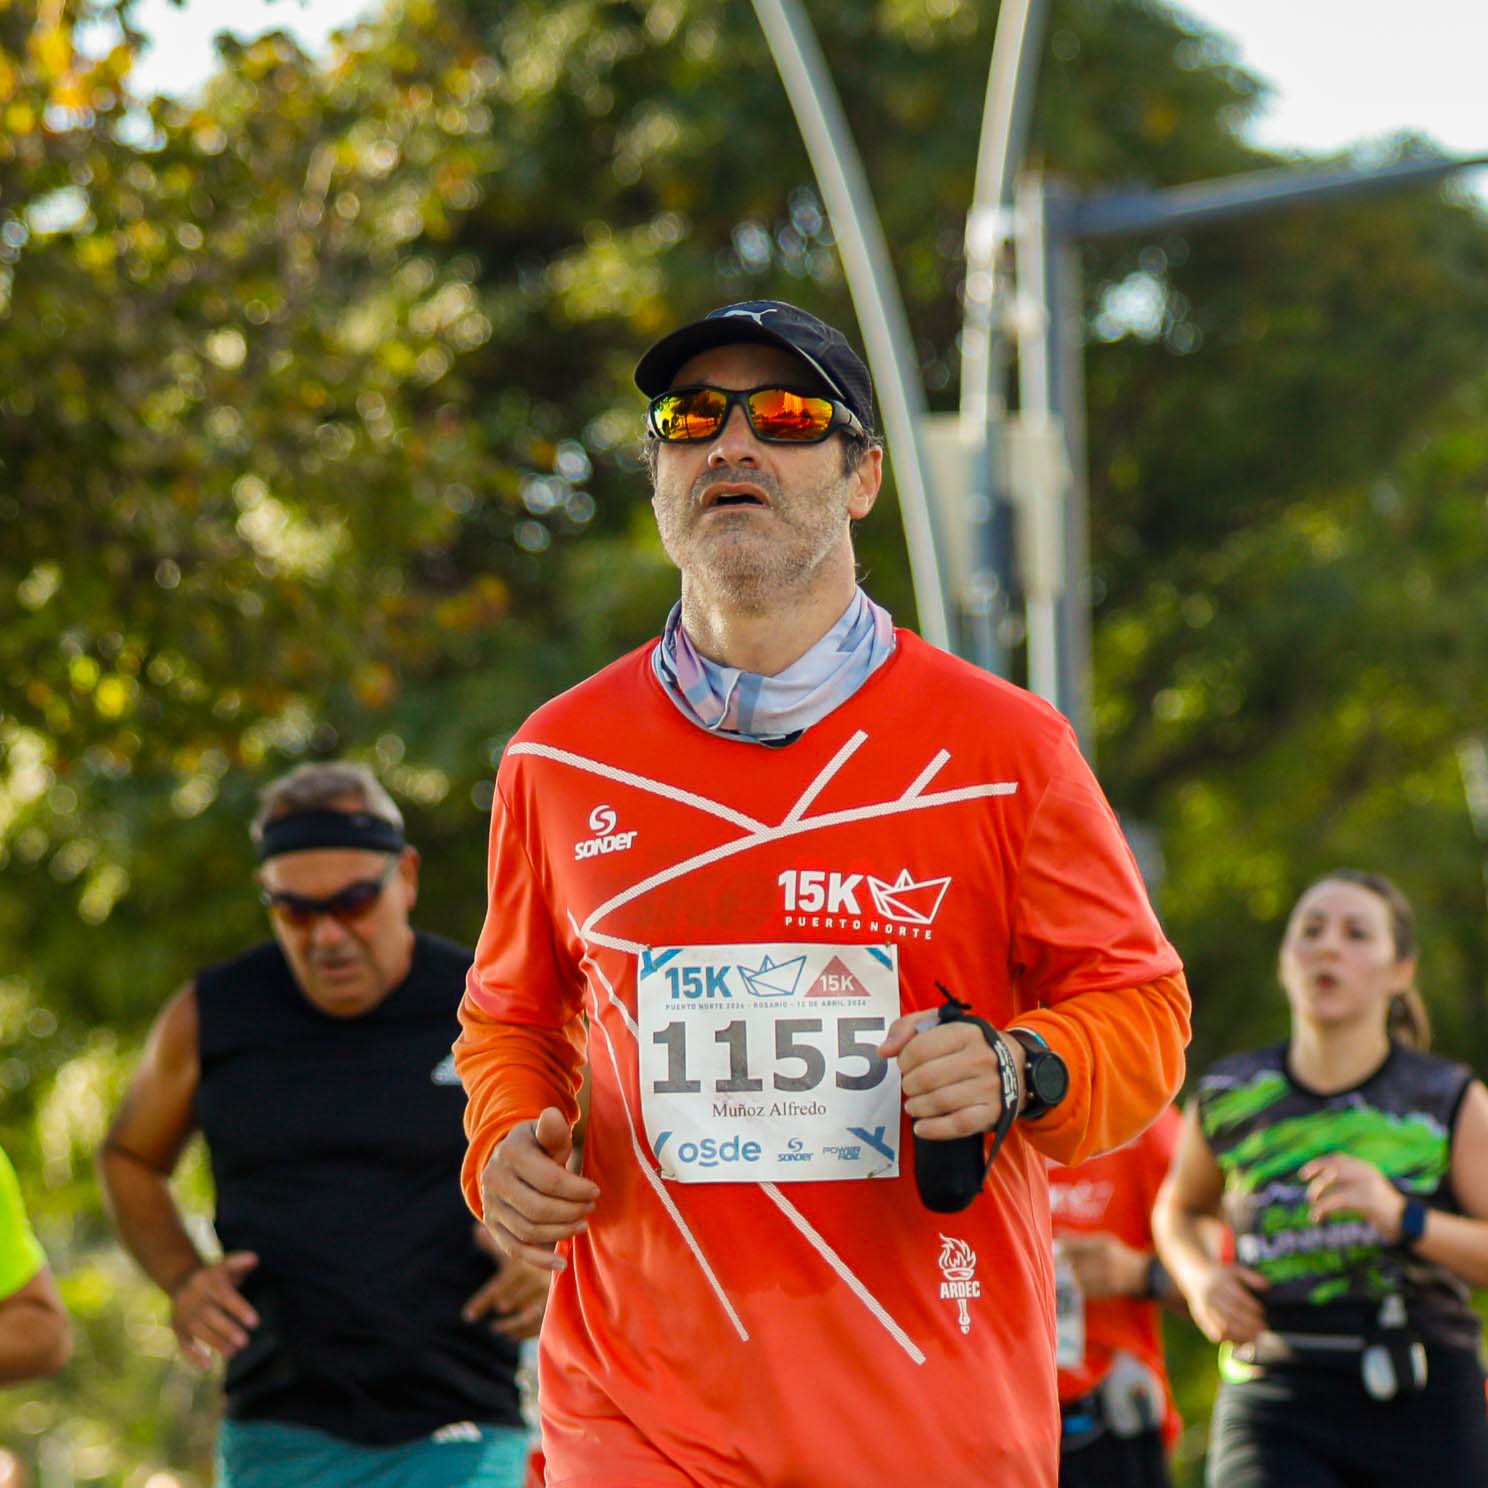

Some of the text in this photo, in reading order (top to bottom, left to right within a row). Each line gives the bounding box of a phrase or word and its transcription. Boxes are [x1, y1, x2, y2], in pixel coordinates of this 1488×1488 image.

[778, 870, 864, 915] 15K
[784, 916, 932, 940] PUERTO NORTE
[665, 965, 733, 999] 15K
[819, 974, 856, 992] 15K
[652, 1016, 889, 1094] 1155
[712, 1101, 827, 1118] Muñoz Alfredo
[678, 1135, 762, 1164] osde
[940, 1281, 981, 1299] ARDEC
